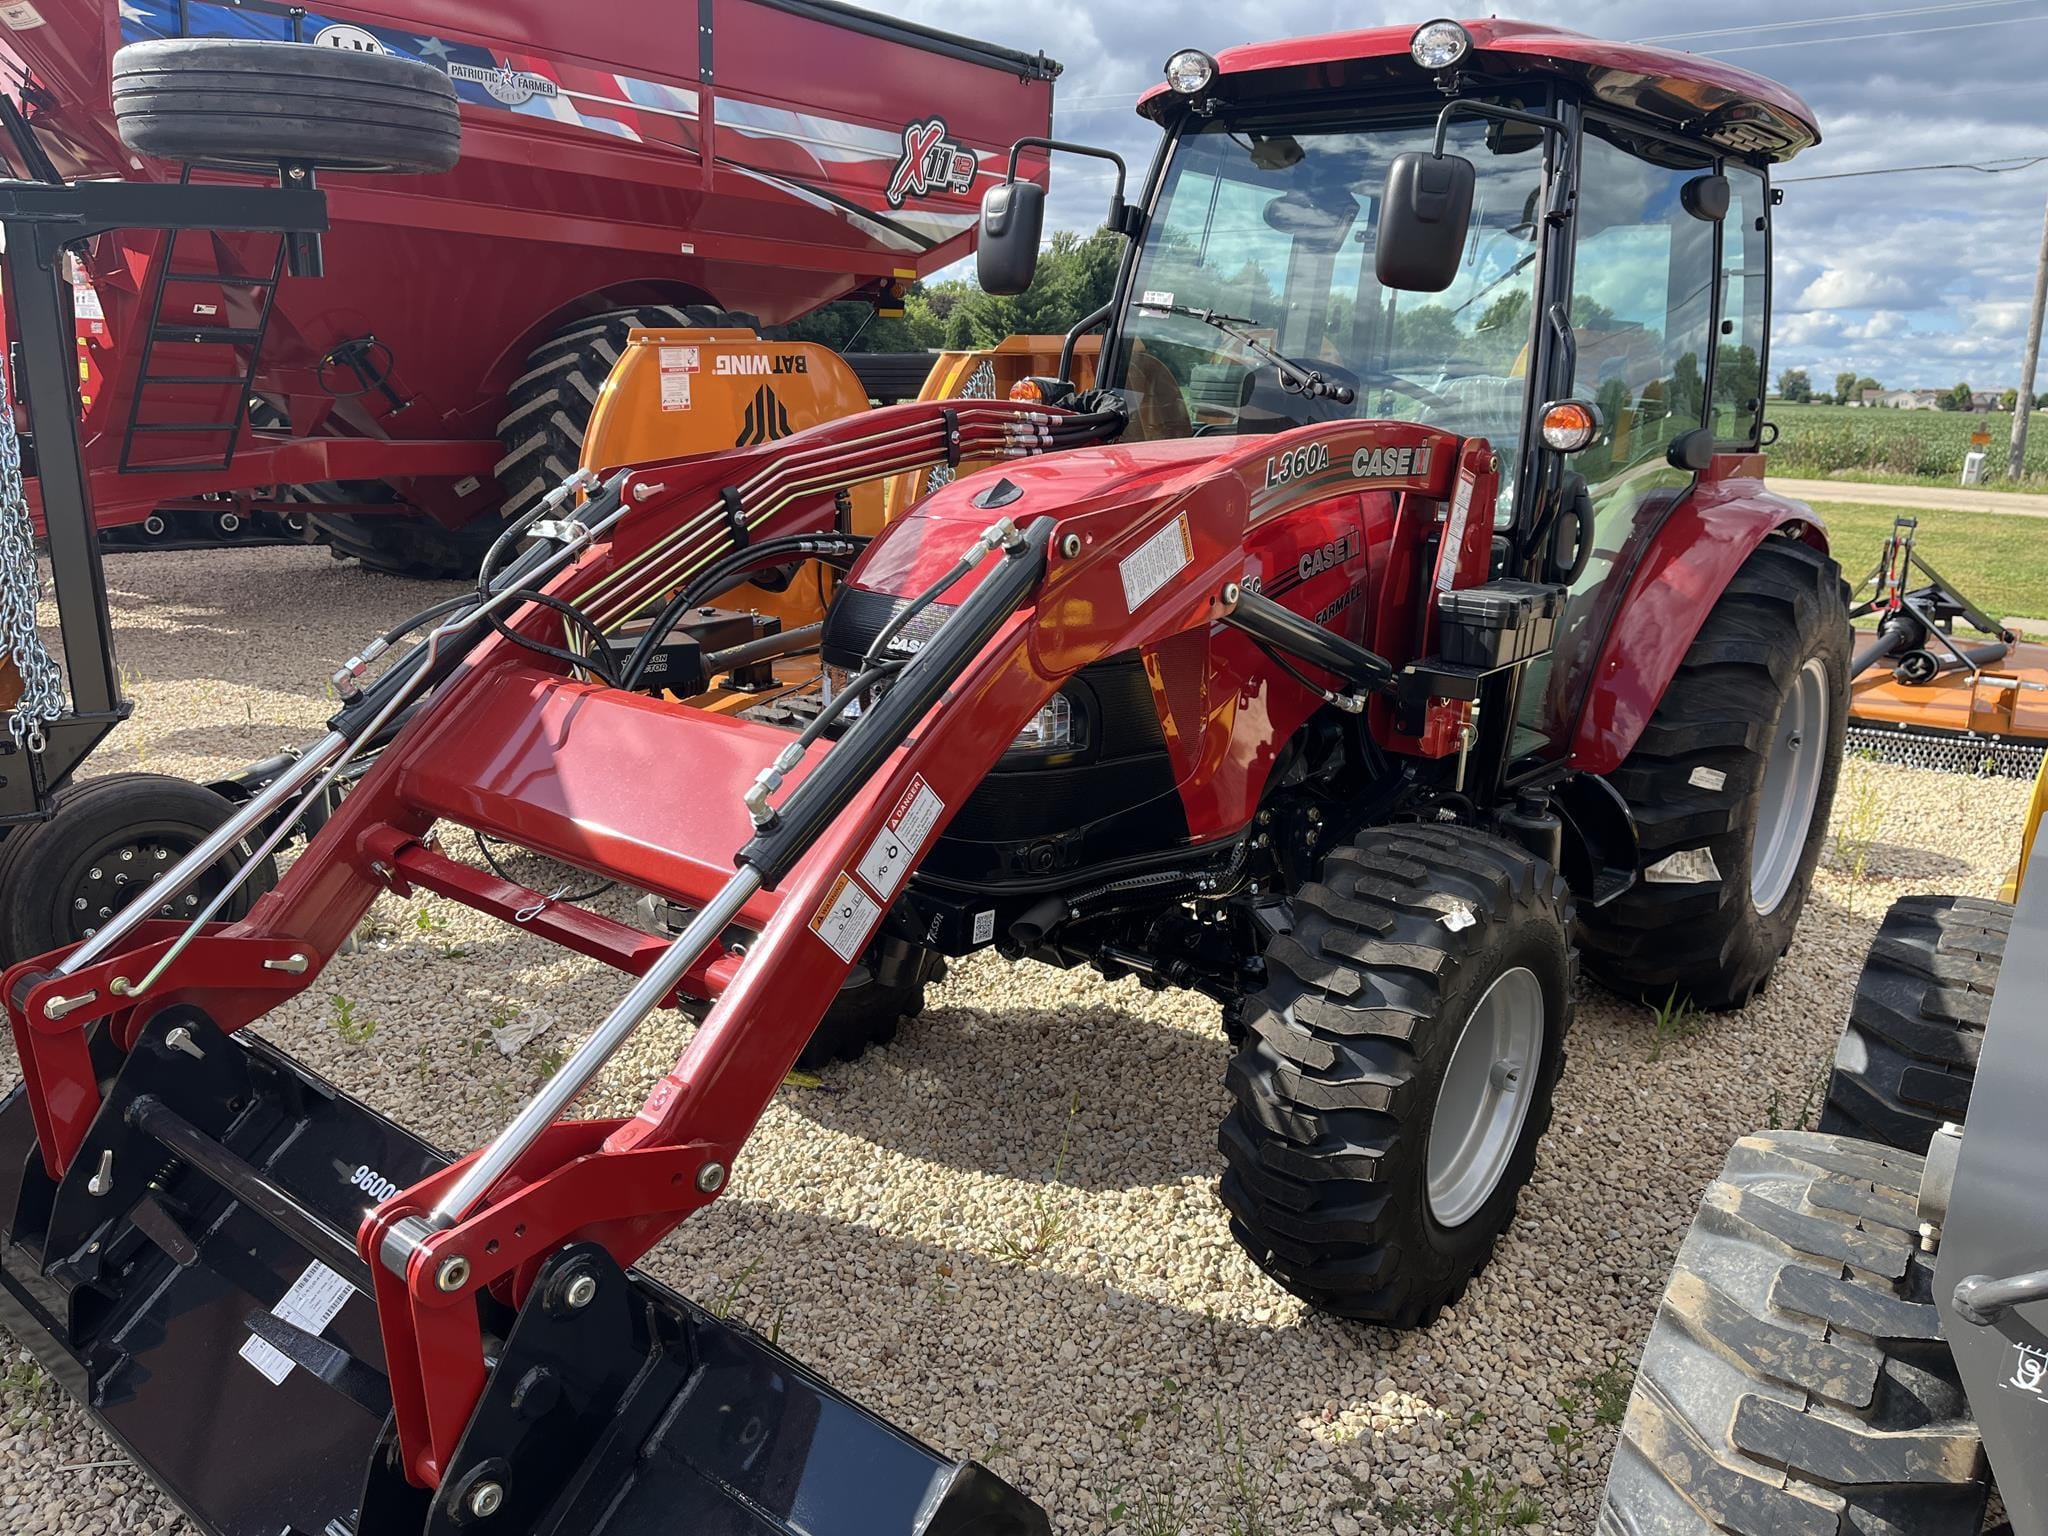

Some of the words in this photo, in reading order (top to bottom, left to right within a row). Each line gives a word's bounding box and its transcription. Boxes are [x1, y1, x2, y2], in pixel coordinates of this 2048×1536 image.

[451, 65, 499, 83] PATRIOTIC
[518, 78, 554, 95] FARMER
[953, 182, 969, 195] HD
[1264, 442, 1330, 491] L360A
[1351, 447, 1412, 478] CASE
[1299, 537, 1346, 580] CASE
[1314, 583, 1362, 625] FARMALL
[896, 781, 921, 818] DANGER
[821, 881, 845, 916] WARNING
[350, 1165, 404, 1203] 9600
